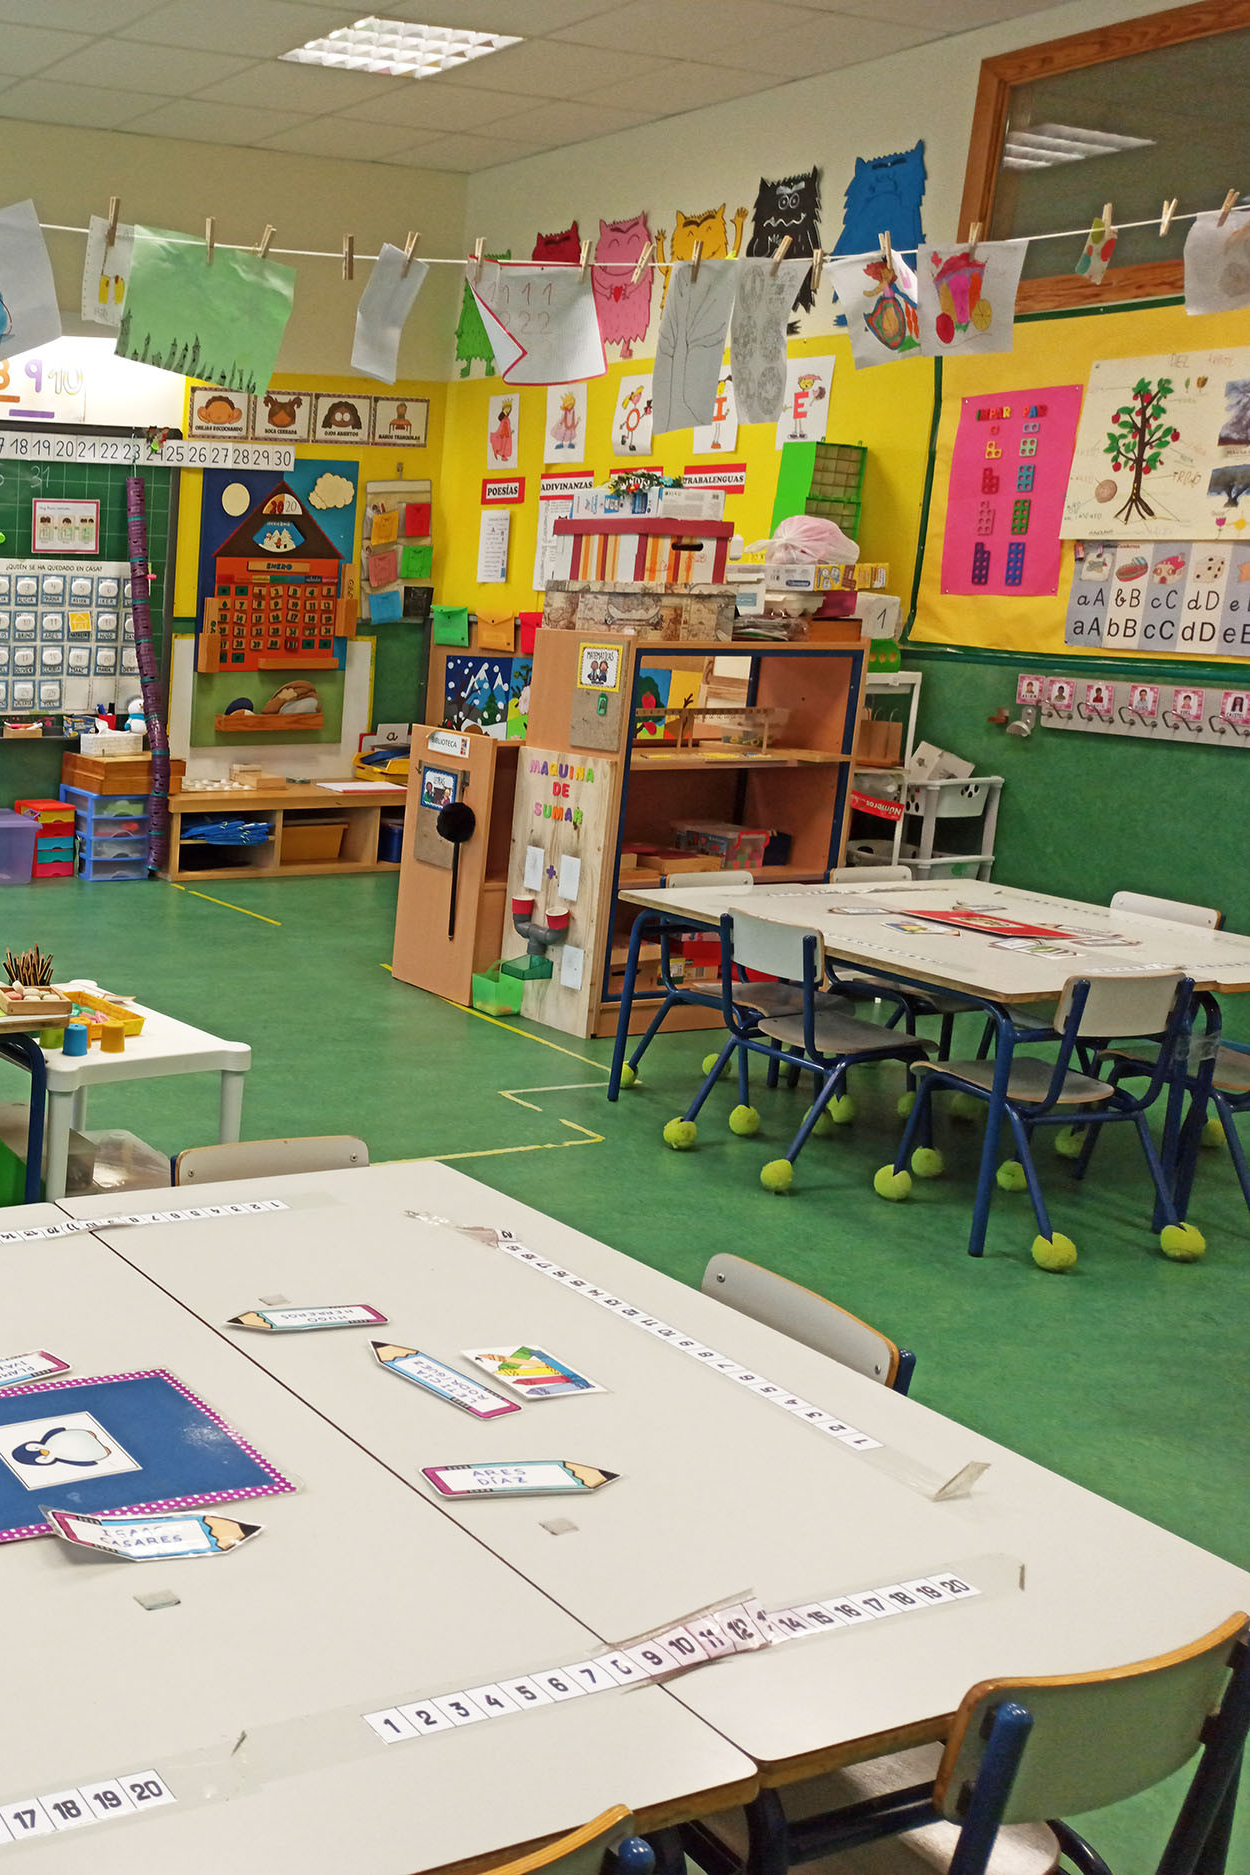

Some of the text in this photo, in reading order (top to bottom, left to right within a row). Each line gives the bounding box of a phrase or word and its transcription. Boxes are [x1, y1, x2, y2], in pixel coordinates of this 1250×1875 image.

[24, 359, 42, 393] 9
[56, 440, 75, 457] 20
[274, 450, 292, 467] 30
[487, 484, 518, 496] POESÍAS
[541, 480, 593, 491] ADIVINANZAS
[266, 562, 293, 571] ENERO
[530, 760, 594, 783] MAQUINA
[552, 782, 570, 798] DE
[534, 803, 583, 824] SUMAR
[471, 1466, 526, 1479] ARES
[477, 1474, 528, 1487] DÍAZ
[100, 1533, 183, 1548] CASARES
[383, 1578, 971, 1733] 1 2 3 4 5 6 7 9 10 11 14 15 16 17 18 19 20
[12, 1809, 38, 1830] 17
[52, 1799, 81, 1820] 18
[93, 1790, 122, 1811] 19
[130, 1780, 163, 1800] 20
